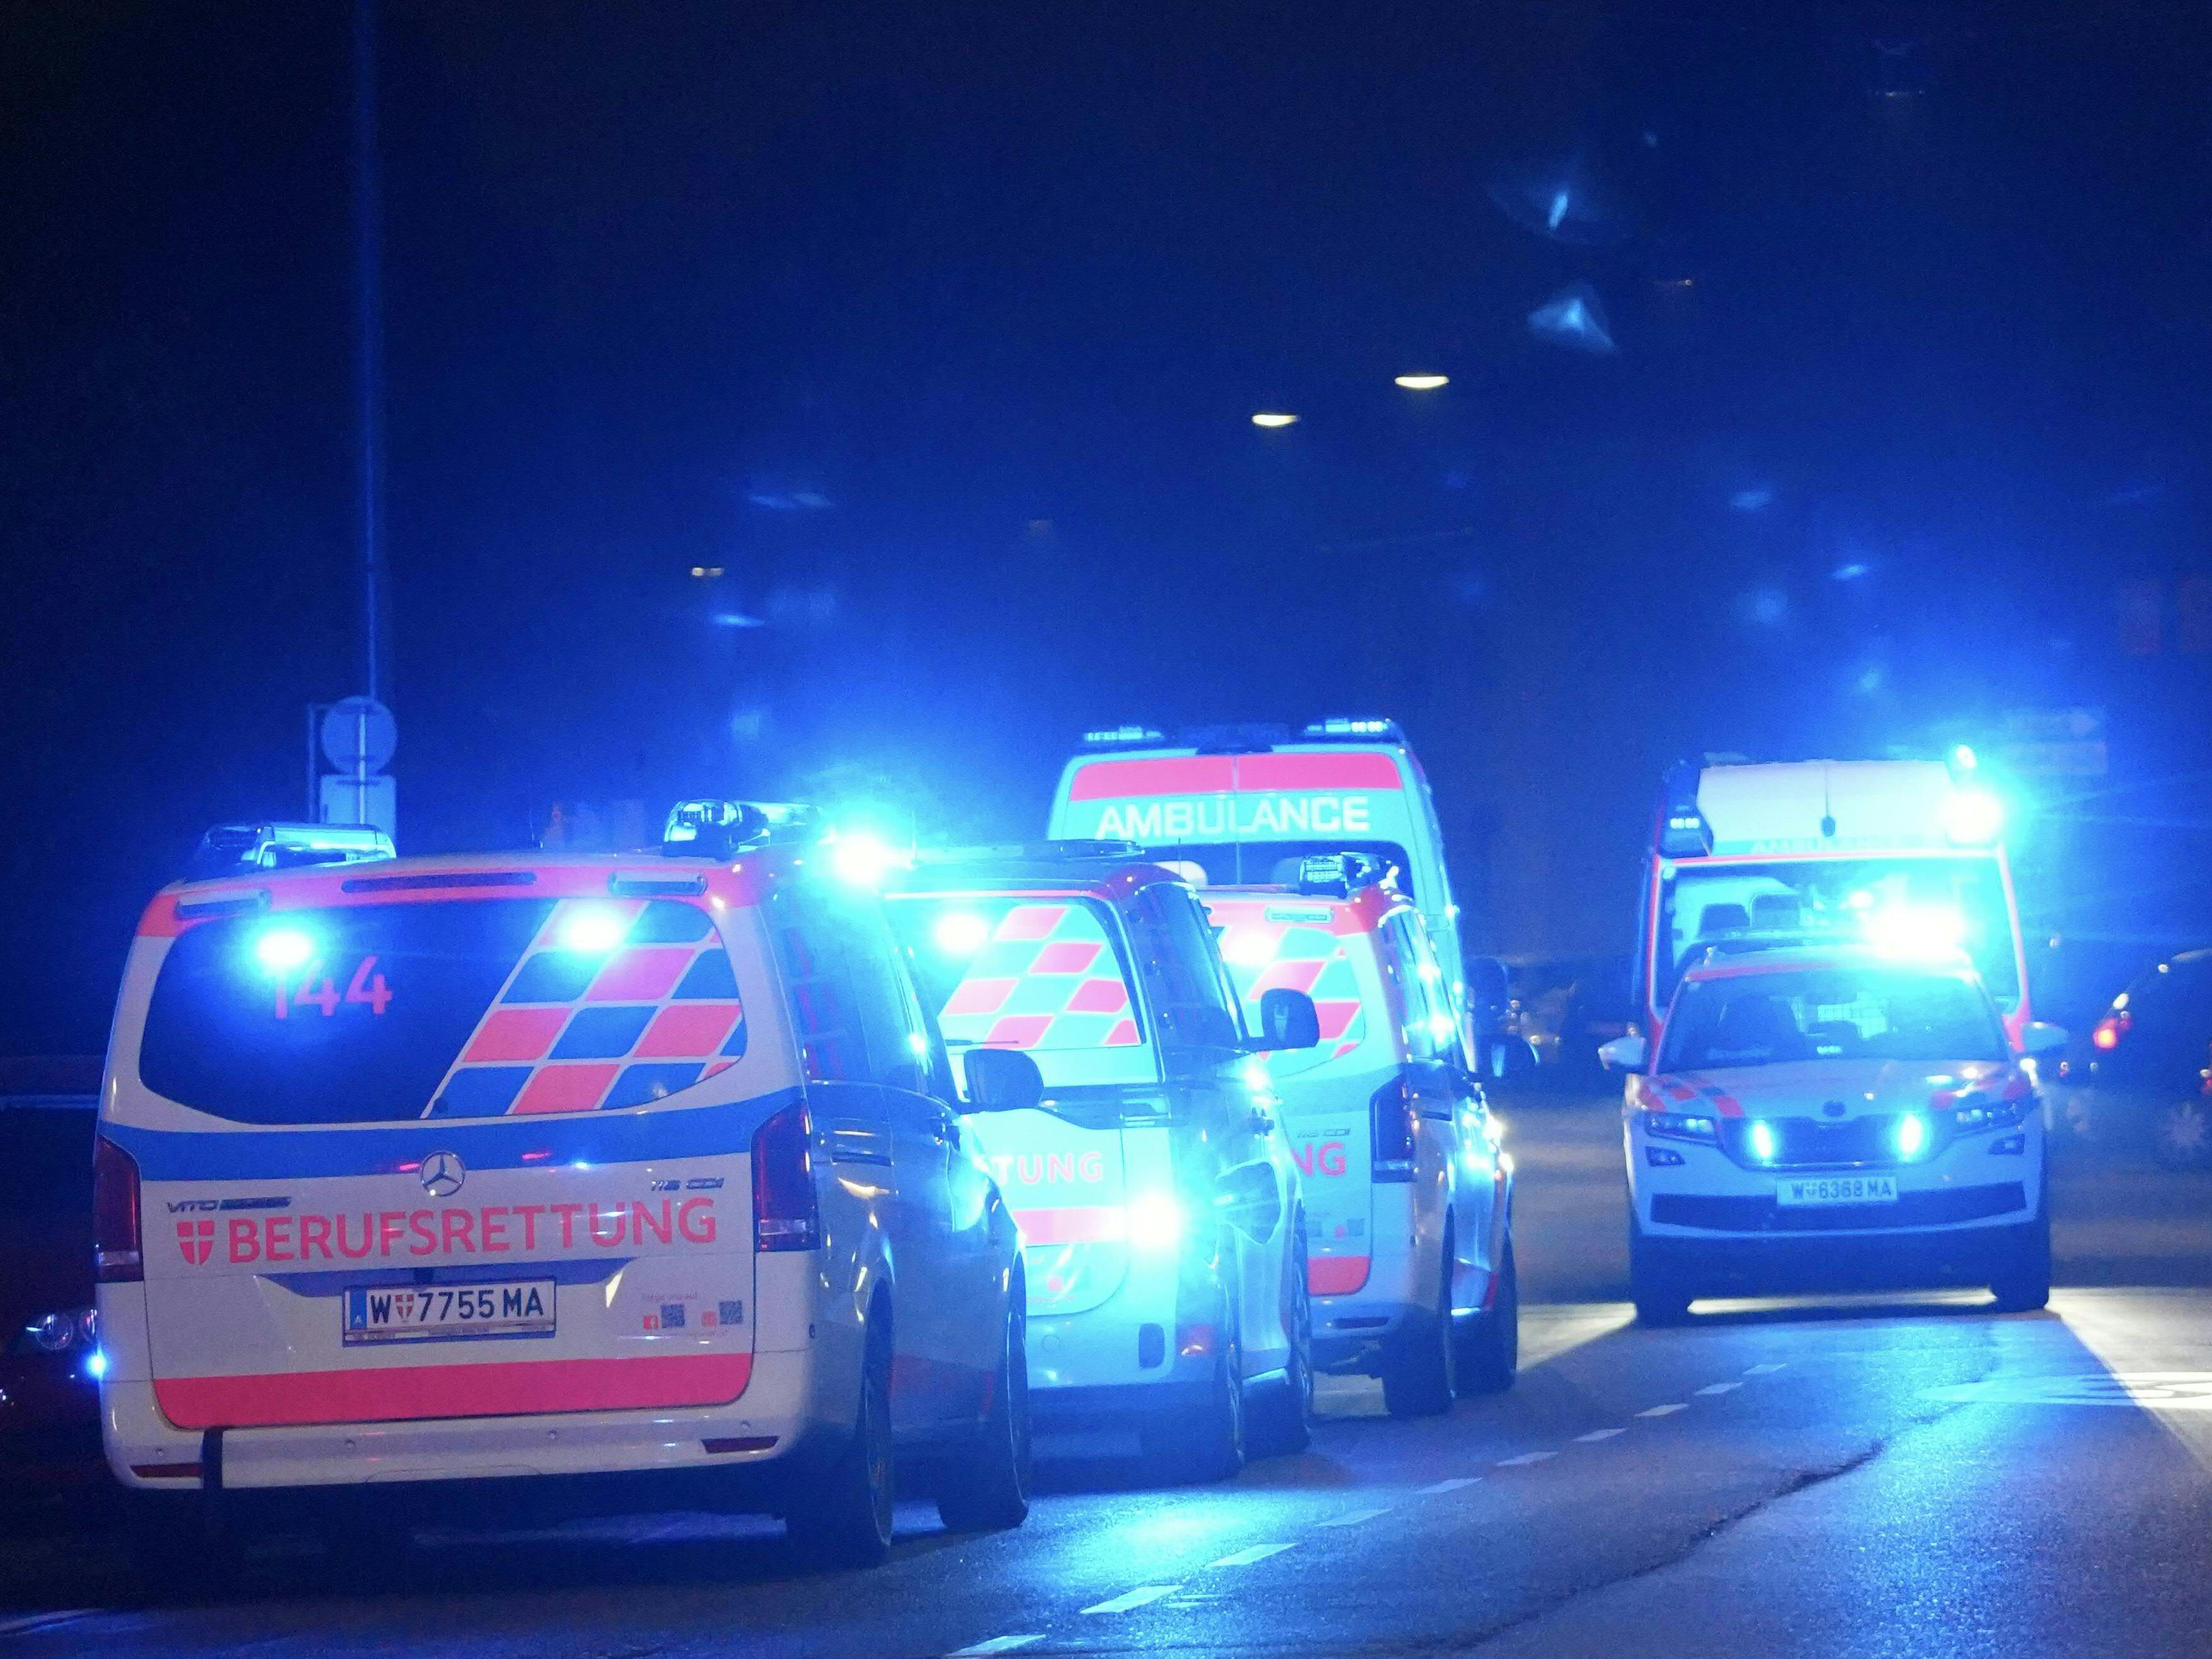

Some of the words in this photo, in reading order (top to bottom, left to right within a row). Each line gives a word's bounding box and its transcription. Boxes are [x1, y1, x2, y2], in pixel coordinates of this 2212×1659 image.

[1094, 795, 1370, 840] AMBULANCE
[274, 955, 393, 1019] 144
[1868, 1178, 1892, 1197] MA
[228, 1197, 716, 1264] BERUFSRETTUNG
[370, 1294, 391, 1324] W
[418, 1289, 494, 1322] 7755
[502, 1287, 544, 1318] MA
